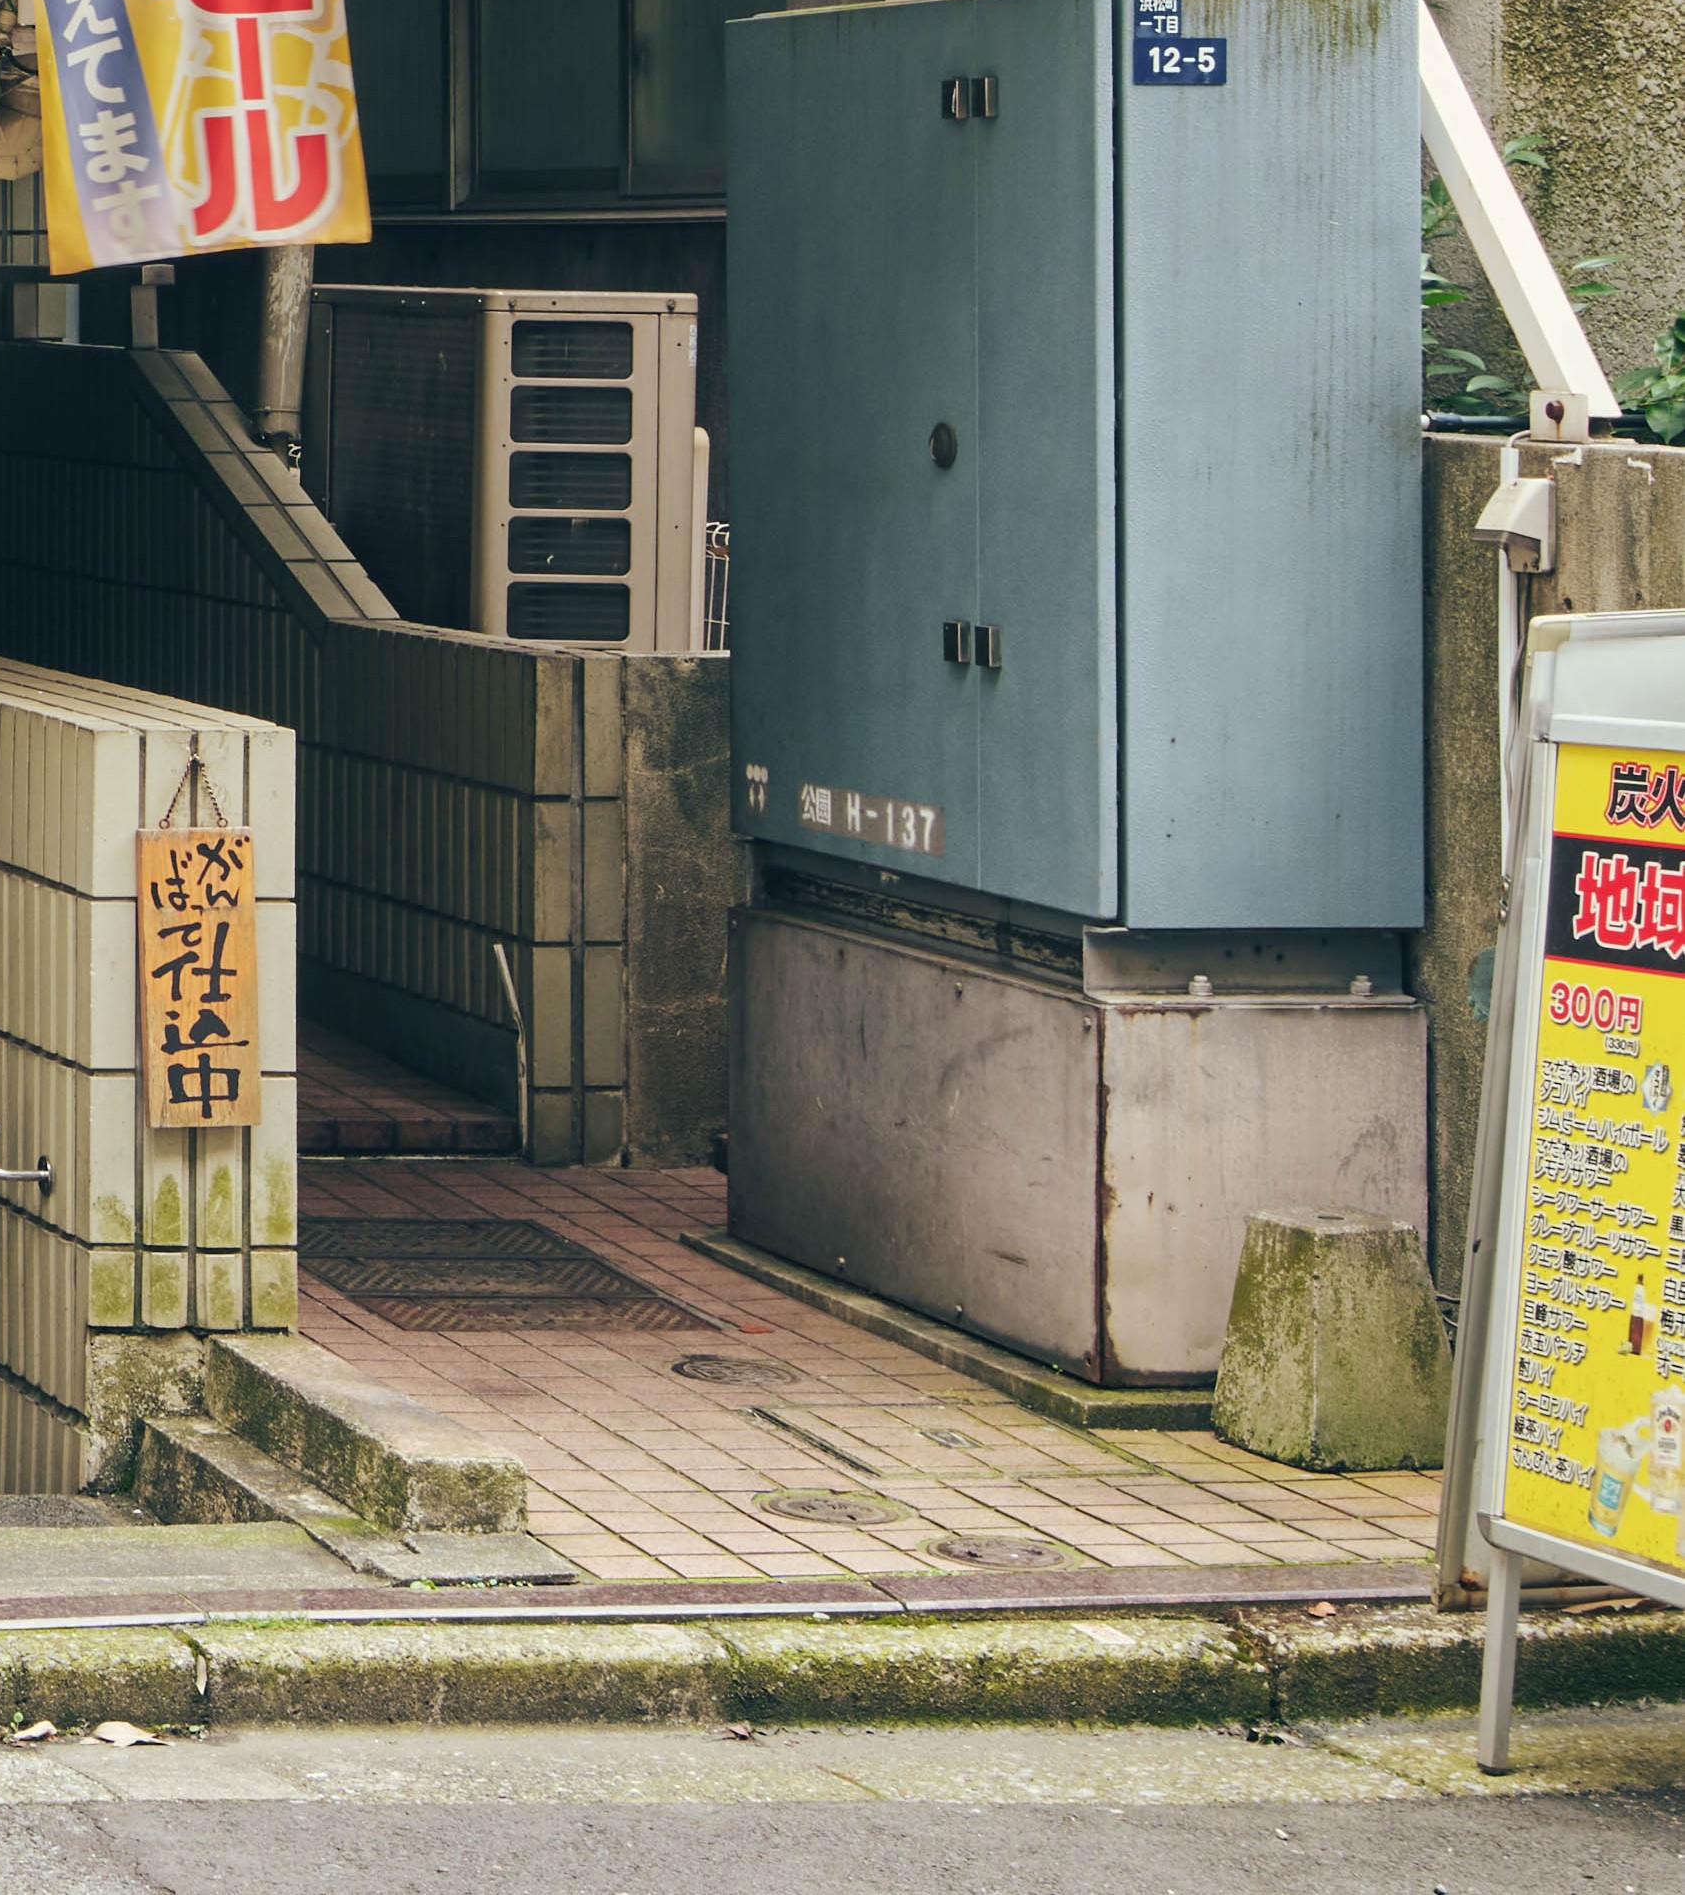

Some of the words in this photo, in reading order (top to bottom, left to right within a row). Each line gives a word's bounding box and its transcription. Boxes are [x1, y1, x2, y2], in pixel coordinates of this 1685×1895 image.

[1139, 15, 1178, 34] 一丁目
[1149, 47, 1215, 73] 12-5
[847, 792, 935, 852] H-137
[1549, 981, 1643, 1034] 300円
[1603, 1035, 1641, 1058] (330円)
[1540, 1079, 1590, 1107] タコハイ
[1542, 1060, 1636, 1095] こだわり酒場の
[1537, 1106, 1669, 1152] ジムビームハイボール
[1535, 1157, 1611, 1186] レモンサワー
[1536, 1138, 1628, 1173] こだわり酒場の
[1531, 1185, 1658, 1225] シークワーサーサワー
[1529, 1214, 1661, 1257] グレープフルーツサワー
[1528, 1243, 1617, 1278] クエン酸サワー
[1526, 1272, 1625, 1309] ヨーグルトサワー
[1516, 1390, 1588, 1426] ウーロンハイ
